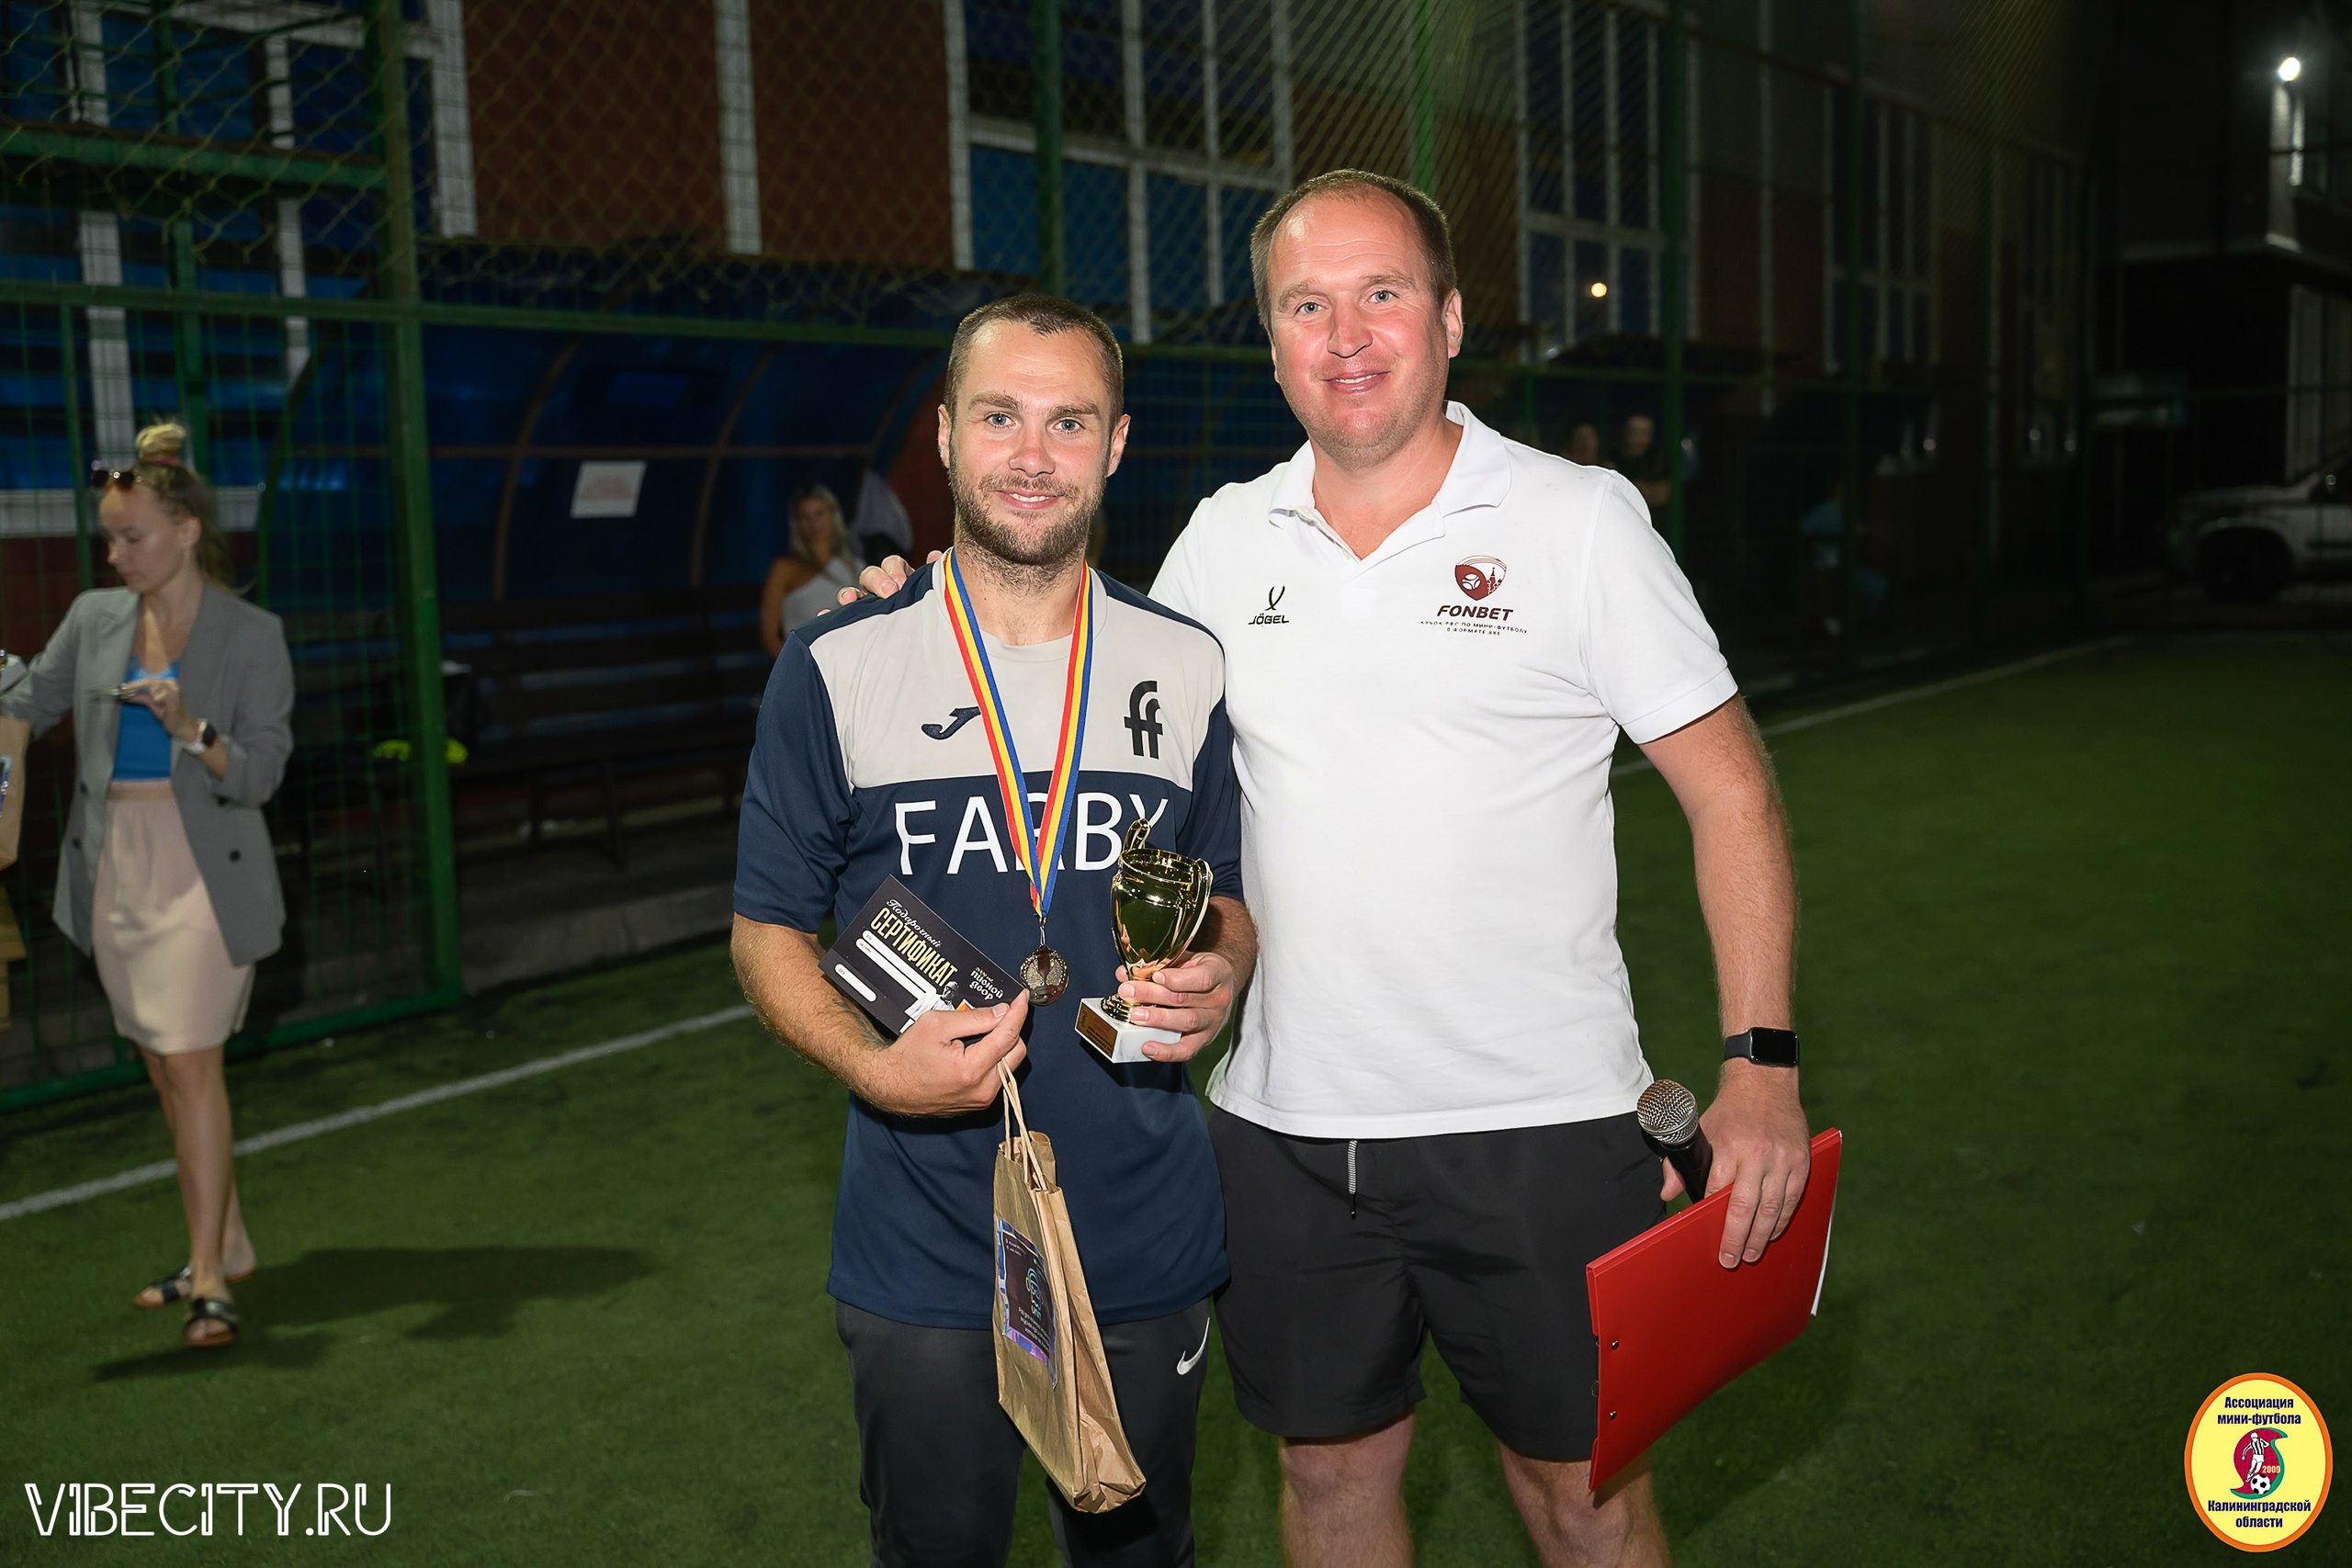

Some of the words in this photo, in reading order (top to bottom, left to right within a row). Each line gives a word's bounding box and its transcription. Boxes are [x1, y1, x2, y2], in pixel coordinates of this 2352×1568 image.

[1436, 604, 1514, 621] FONBET
[870, 908, 958, 987] СЕРТИФИКАТ
[886, 898, 943, 948] Подарочный
